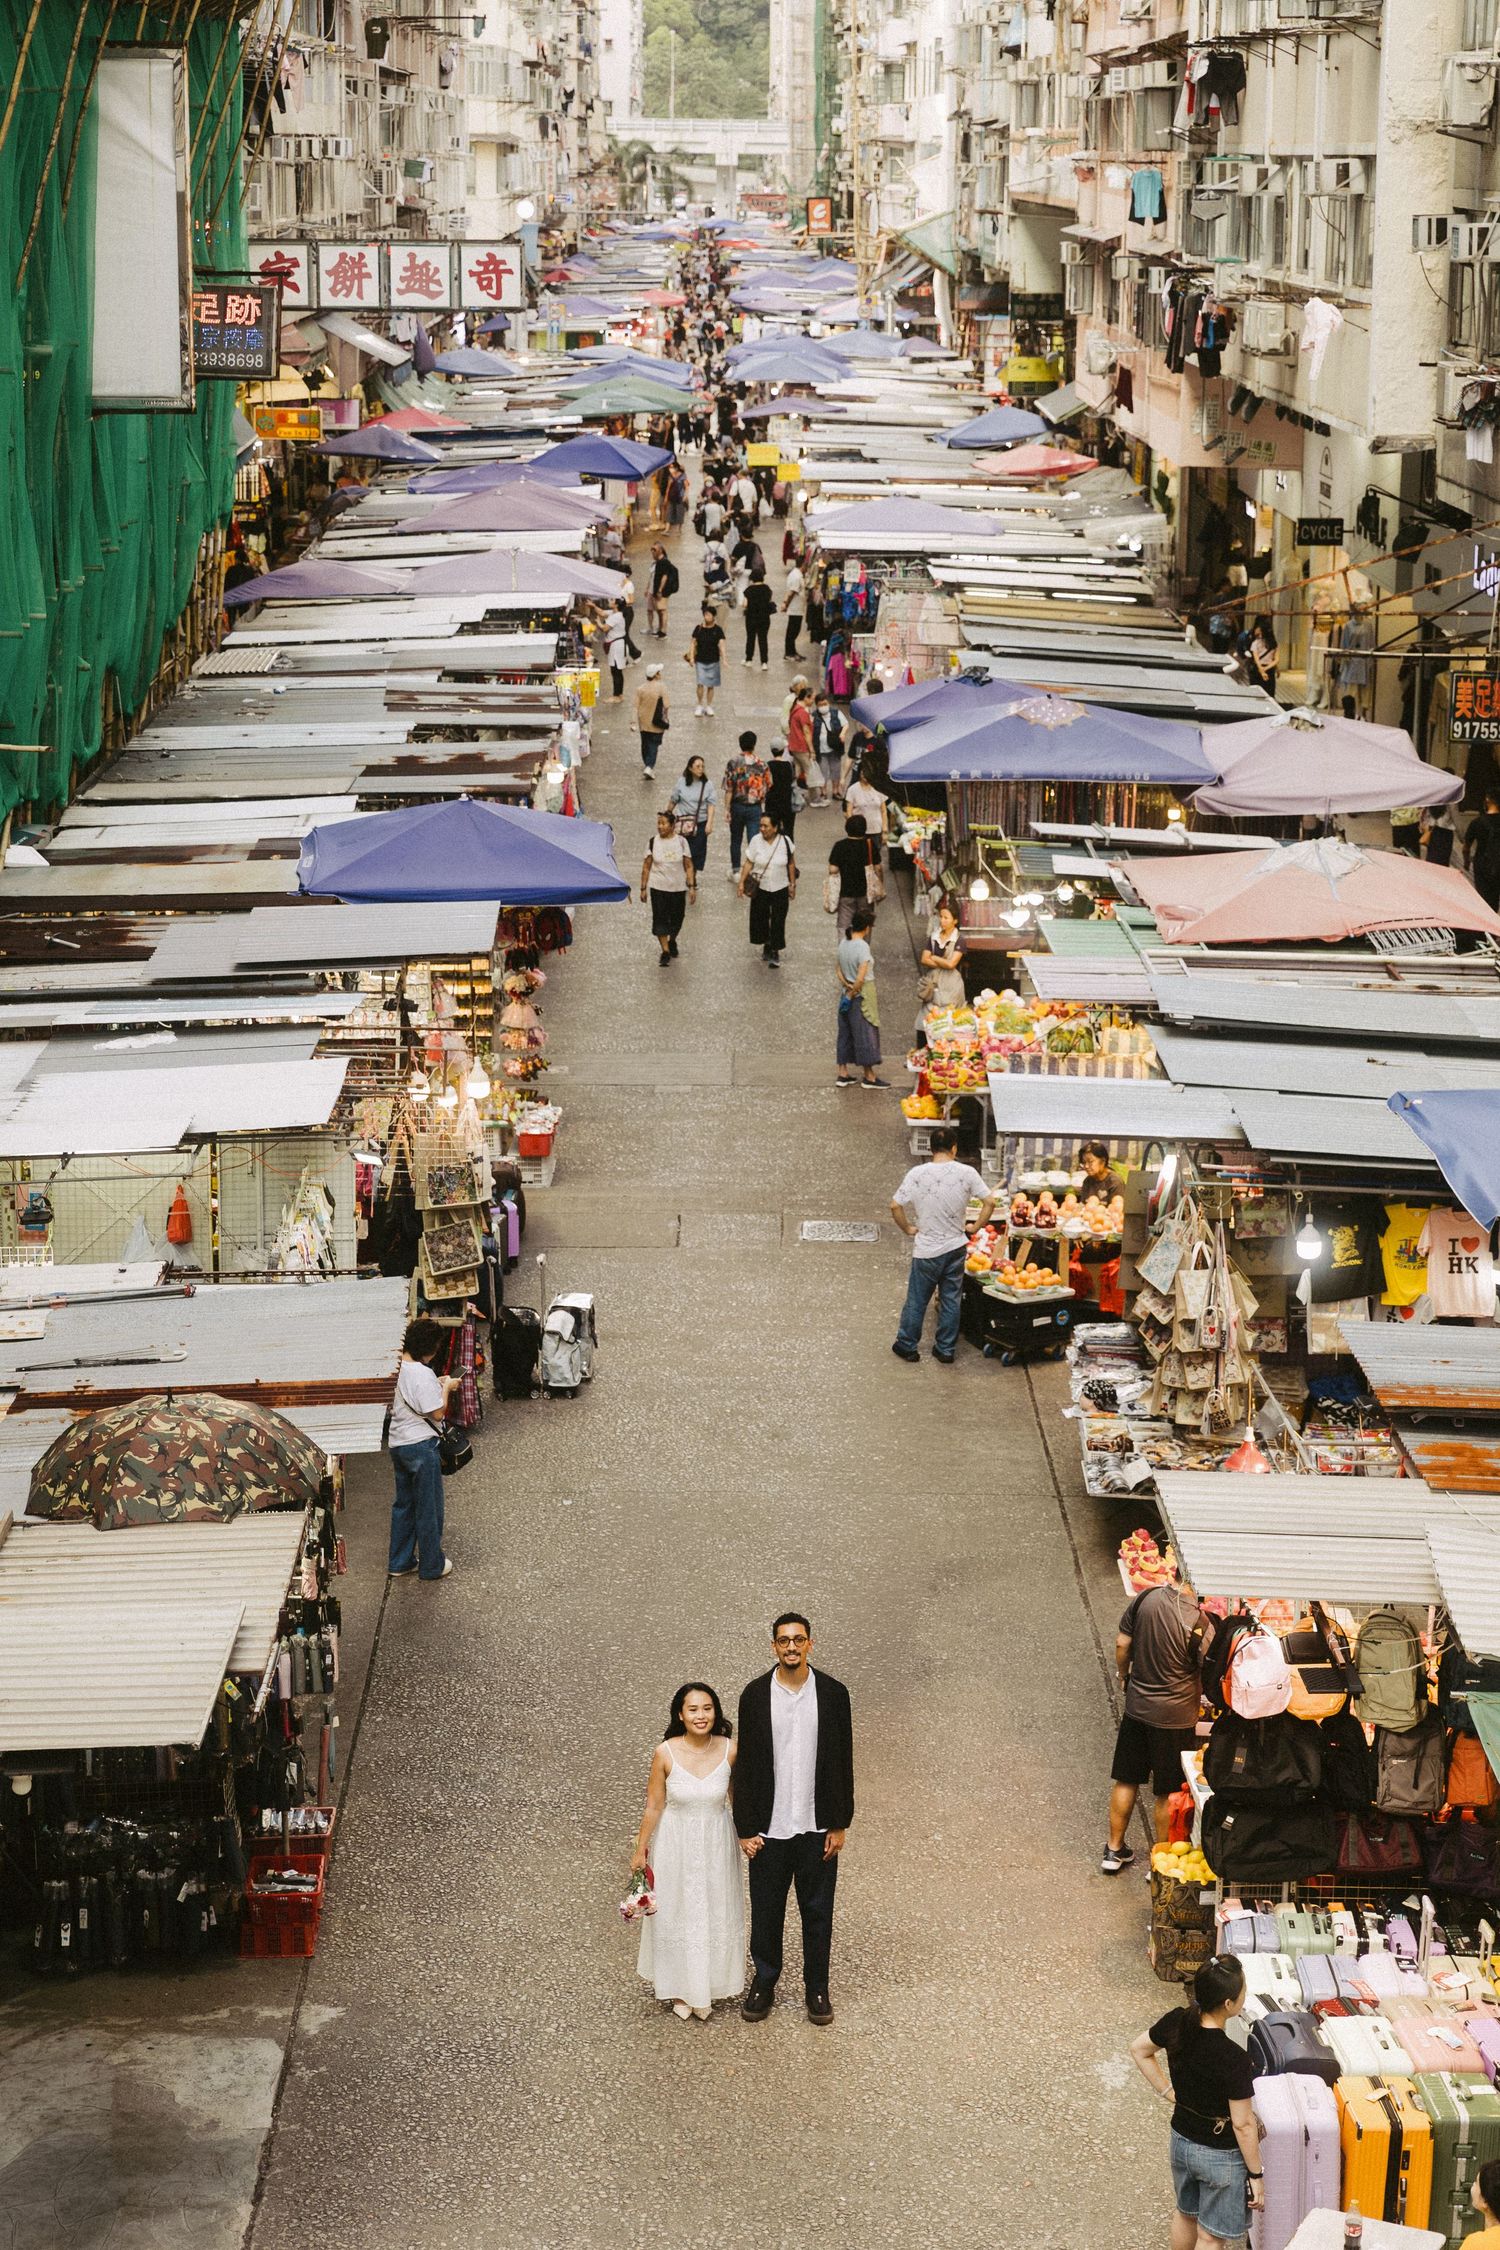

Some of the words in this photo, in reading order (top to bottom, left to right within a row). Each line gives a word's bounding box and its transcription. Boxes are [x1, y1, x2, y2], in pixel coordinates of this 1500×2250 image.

[193, 326, 264, 350] 宗按摩
[1301, 526, 1341, 540] CYCLE
[1453, 721, 1500, 739] 91755
[1448, 1238, 1459, 1256] I
[1448, 1257, 1479, 1274] HK
